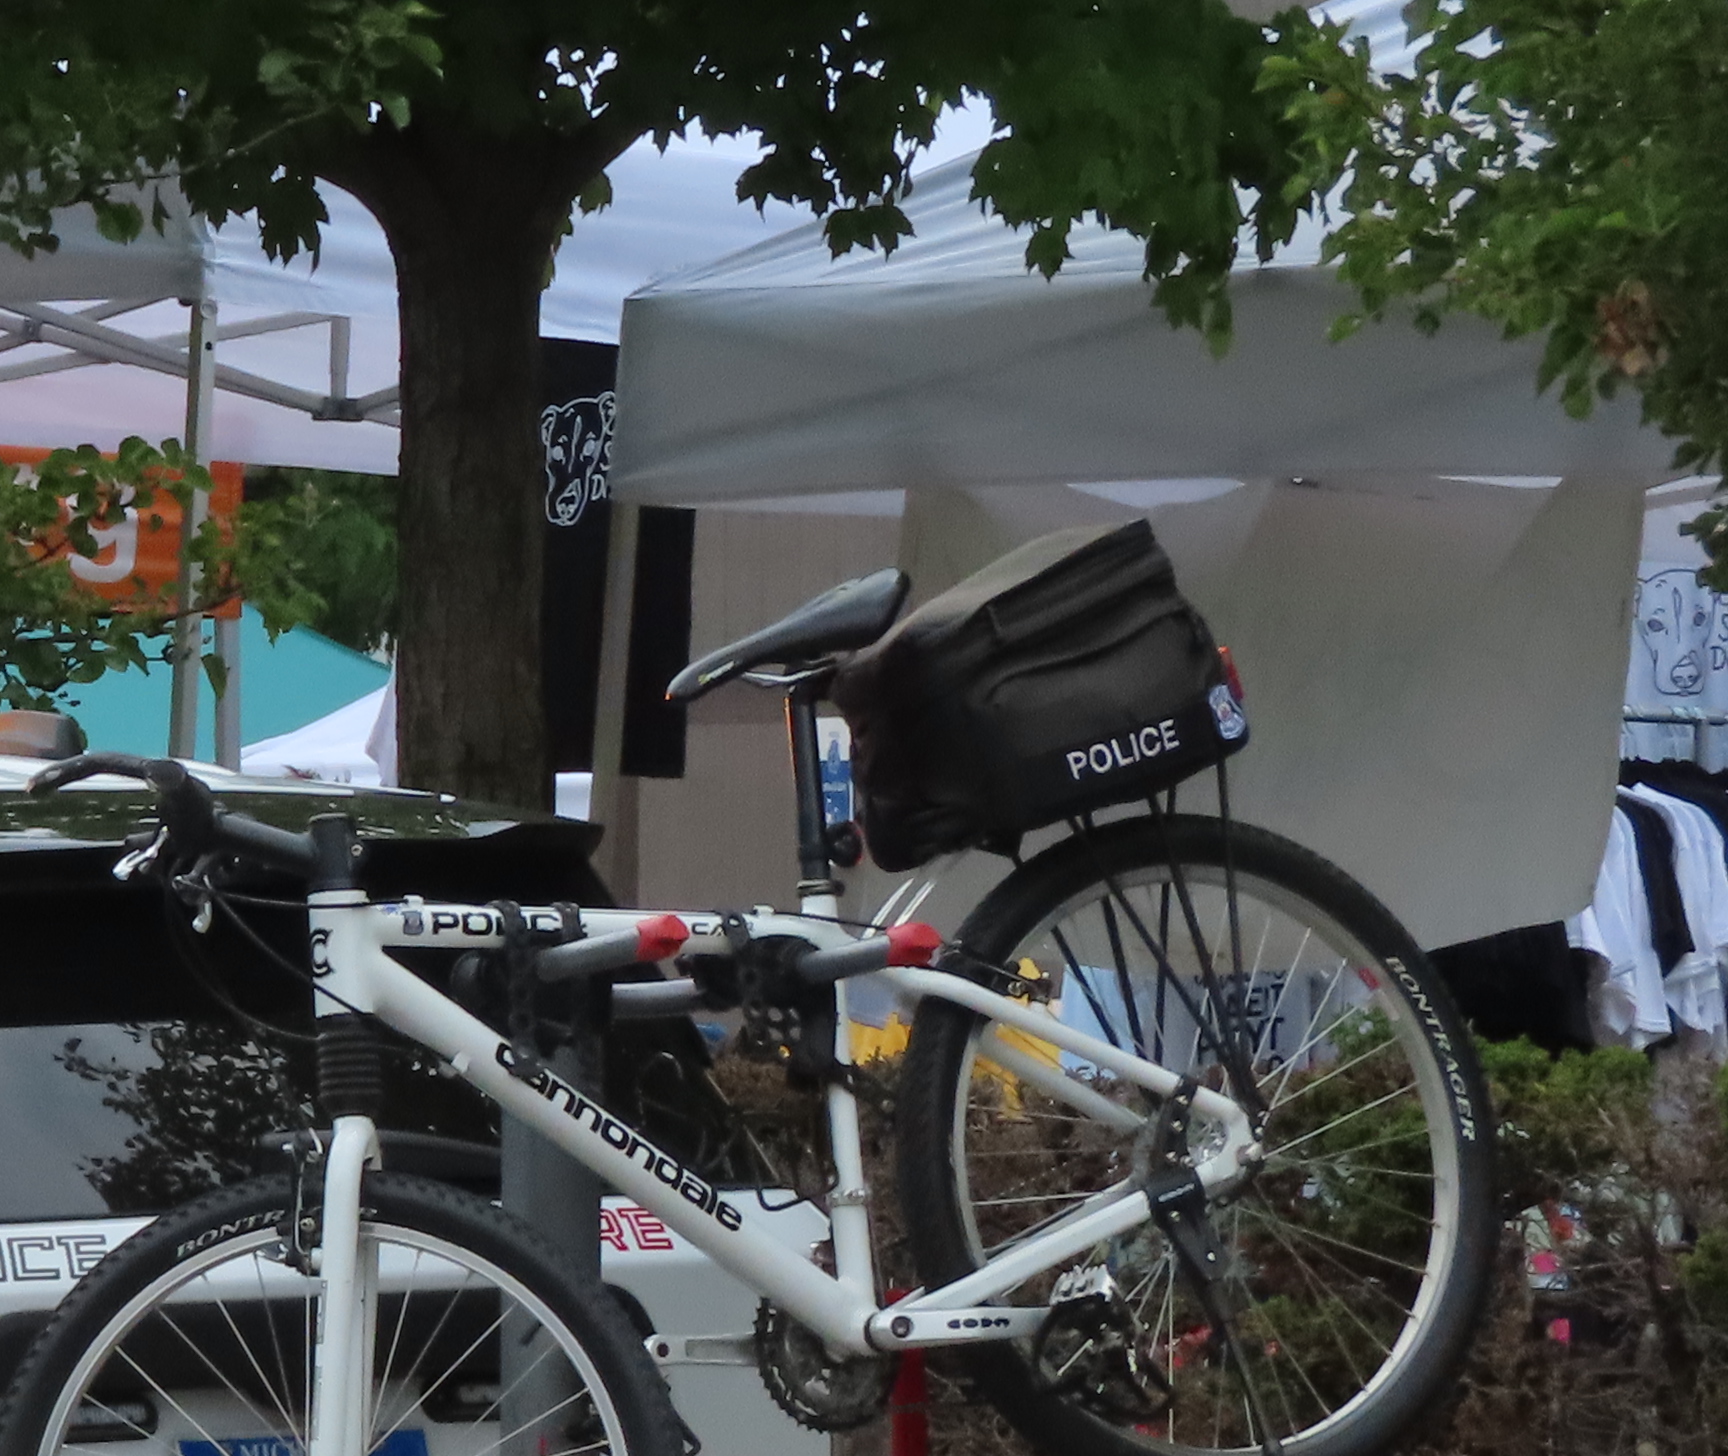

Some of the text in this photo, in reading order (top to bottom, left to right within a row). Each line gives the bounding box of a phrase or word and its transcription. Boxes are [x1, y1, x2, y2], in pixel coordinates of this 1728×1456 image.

[1065, 718, 1181, 781] POLICE
[1385, 955, 1478, 1142] BONTRAGER
[599, 1208, 674, 1252] RE
